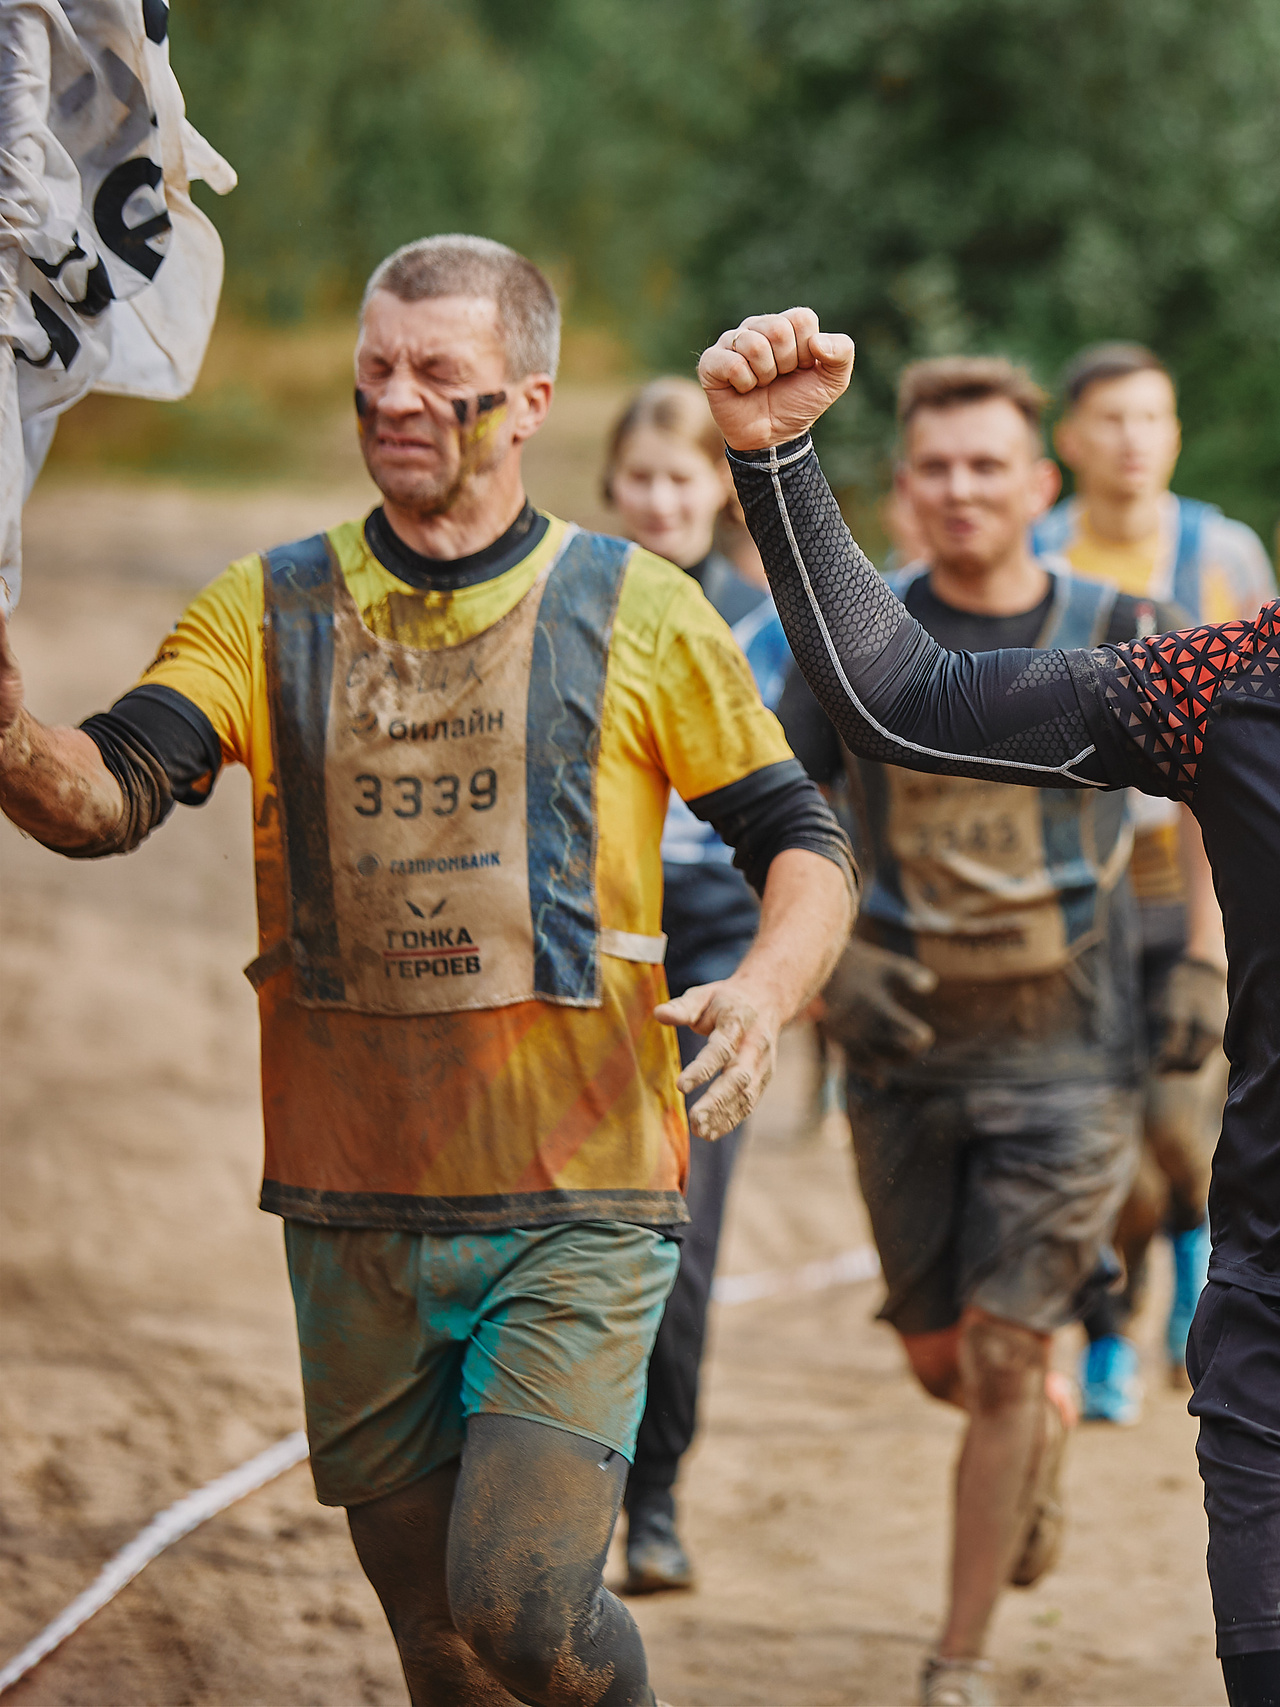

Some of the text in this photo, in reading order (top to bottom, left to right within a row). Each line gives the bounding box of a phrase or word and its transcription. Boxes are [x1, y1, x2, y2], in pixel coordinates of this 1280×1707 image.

[389, 708, 504, 740] билайн
[354, 767, 498, 818] 3339
[390, 852, 501, 875] ГАЗПРОМБАНК
[386, 927, 474, 949] ГОНКА
[384, 955, 481, 979] ГЕРОЕВ
